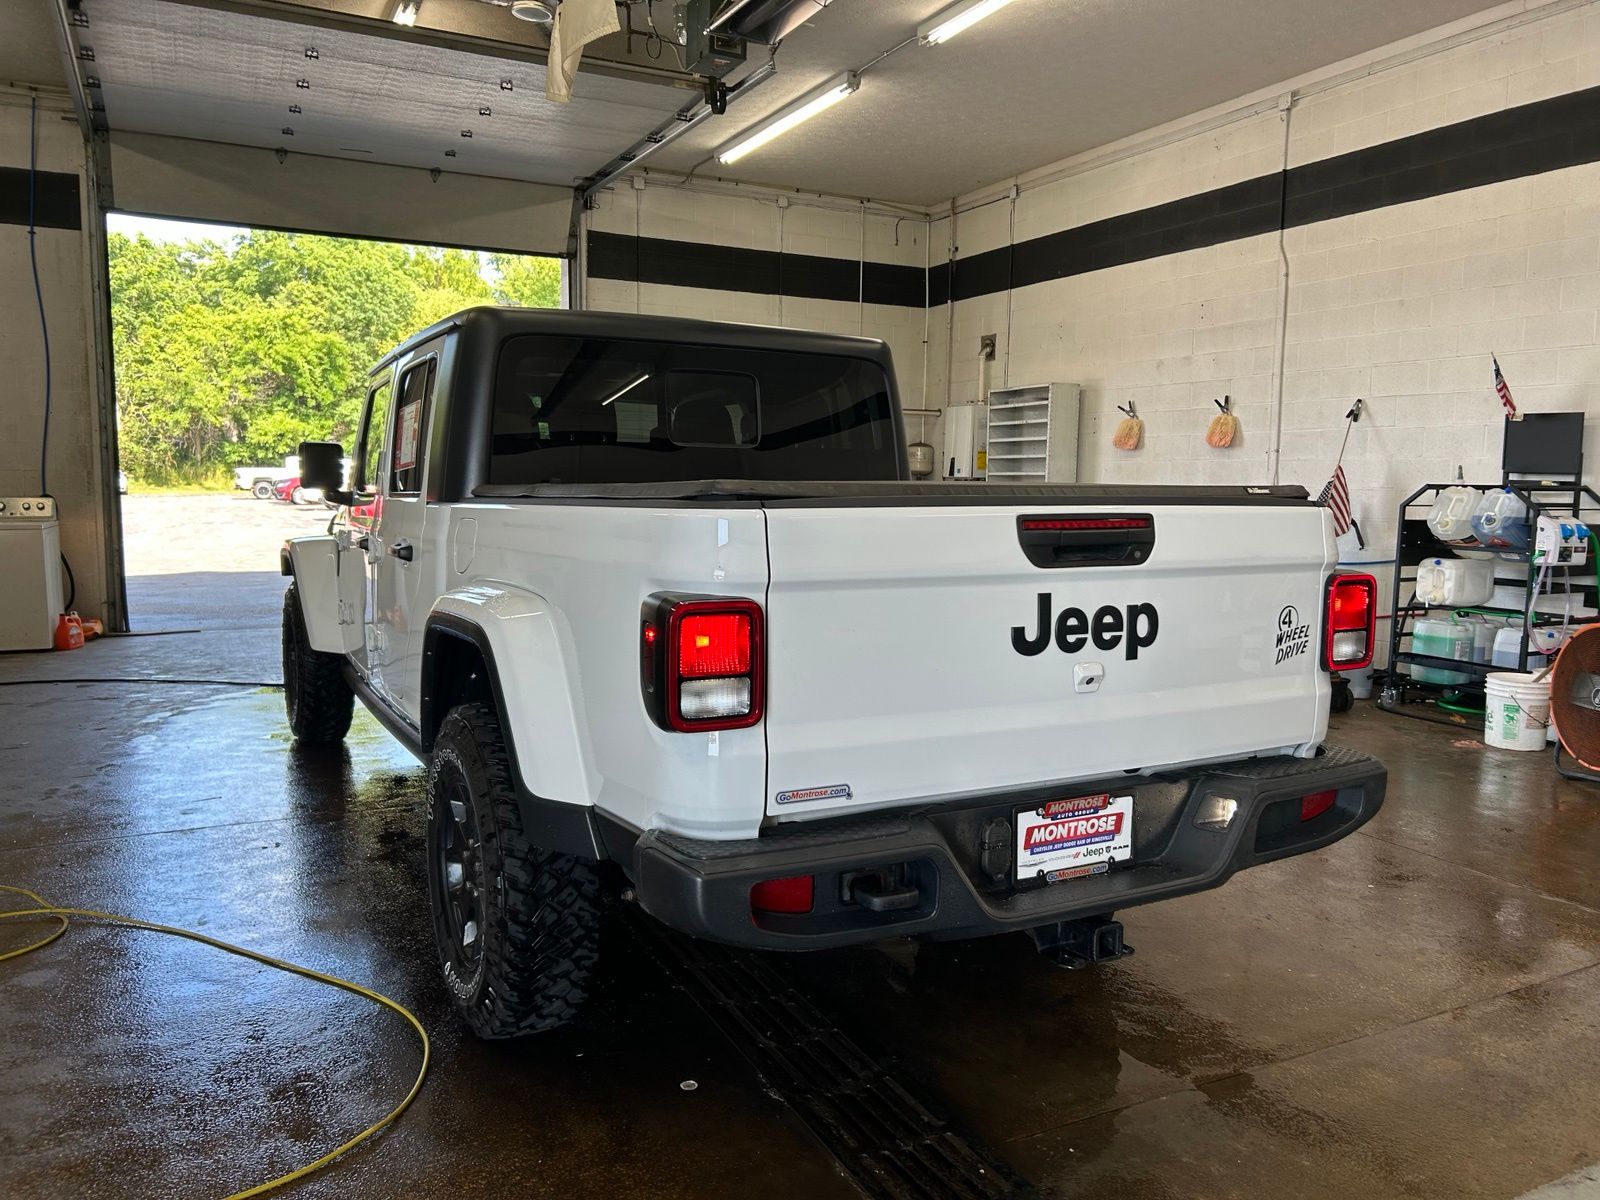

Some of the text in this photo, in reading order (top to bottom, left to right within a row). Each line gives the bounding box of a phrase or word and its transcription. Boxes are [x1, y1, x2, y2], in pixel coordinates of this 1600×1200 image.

[1010, 592, 1159, 660] Jeep
[1281, 609, 1292, 628] 4
[1275, 625, 1310, 648] WHEEL
[1275, 640, 1308, 665] DRIVE
[779, 787, 847, 802] GoMontrose.com
[1049, 796, 1105, 814] MONTROSE
[1074, 809, 1094, 817] GROUP
[1030, 815, 1117, 844] MONTROSE
[1083, 847, 1104, 857] Jeep
[1047, 864, 1107, 881] GoMontrose.com
